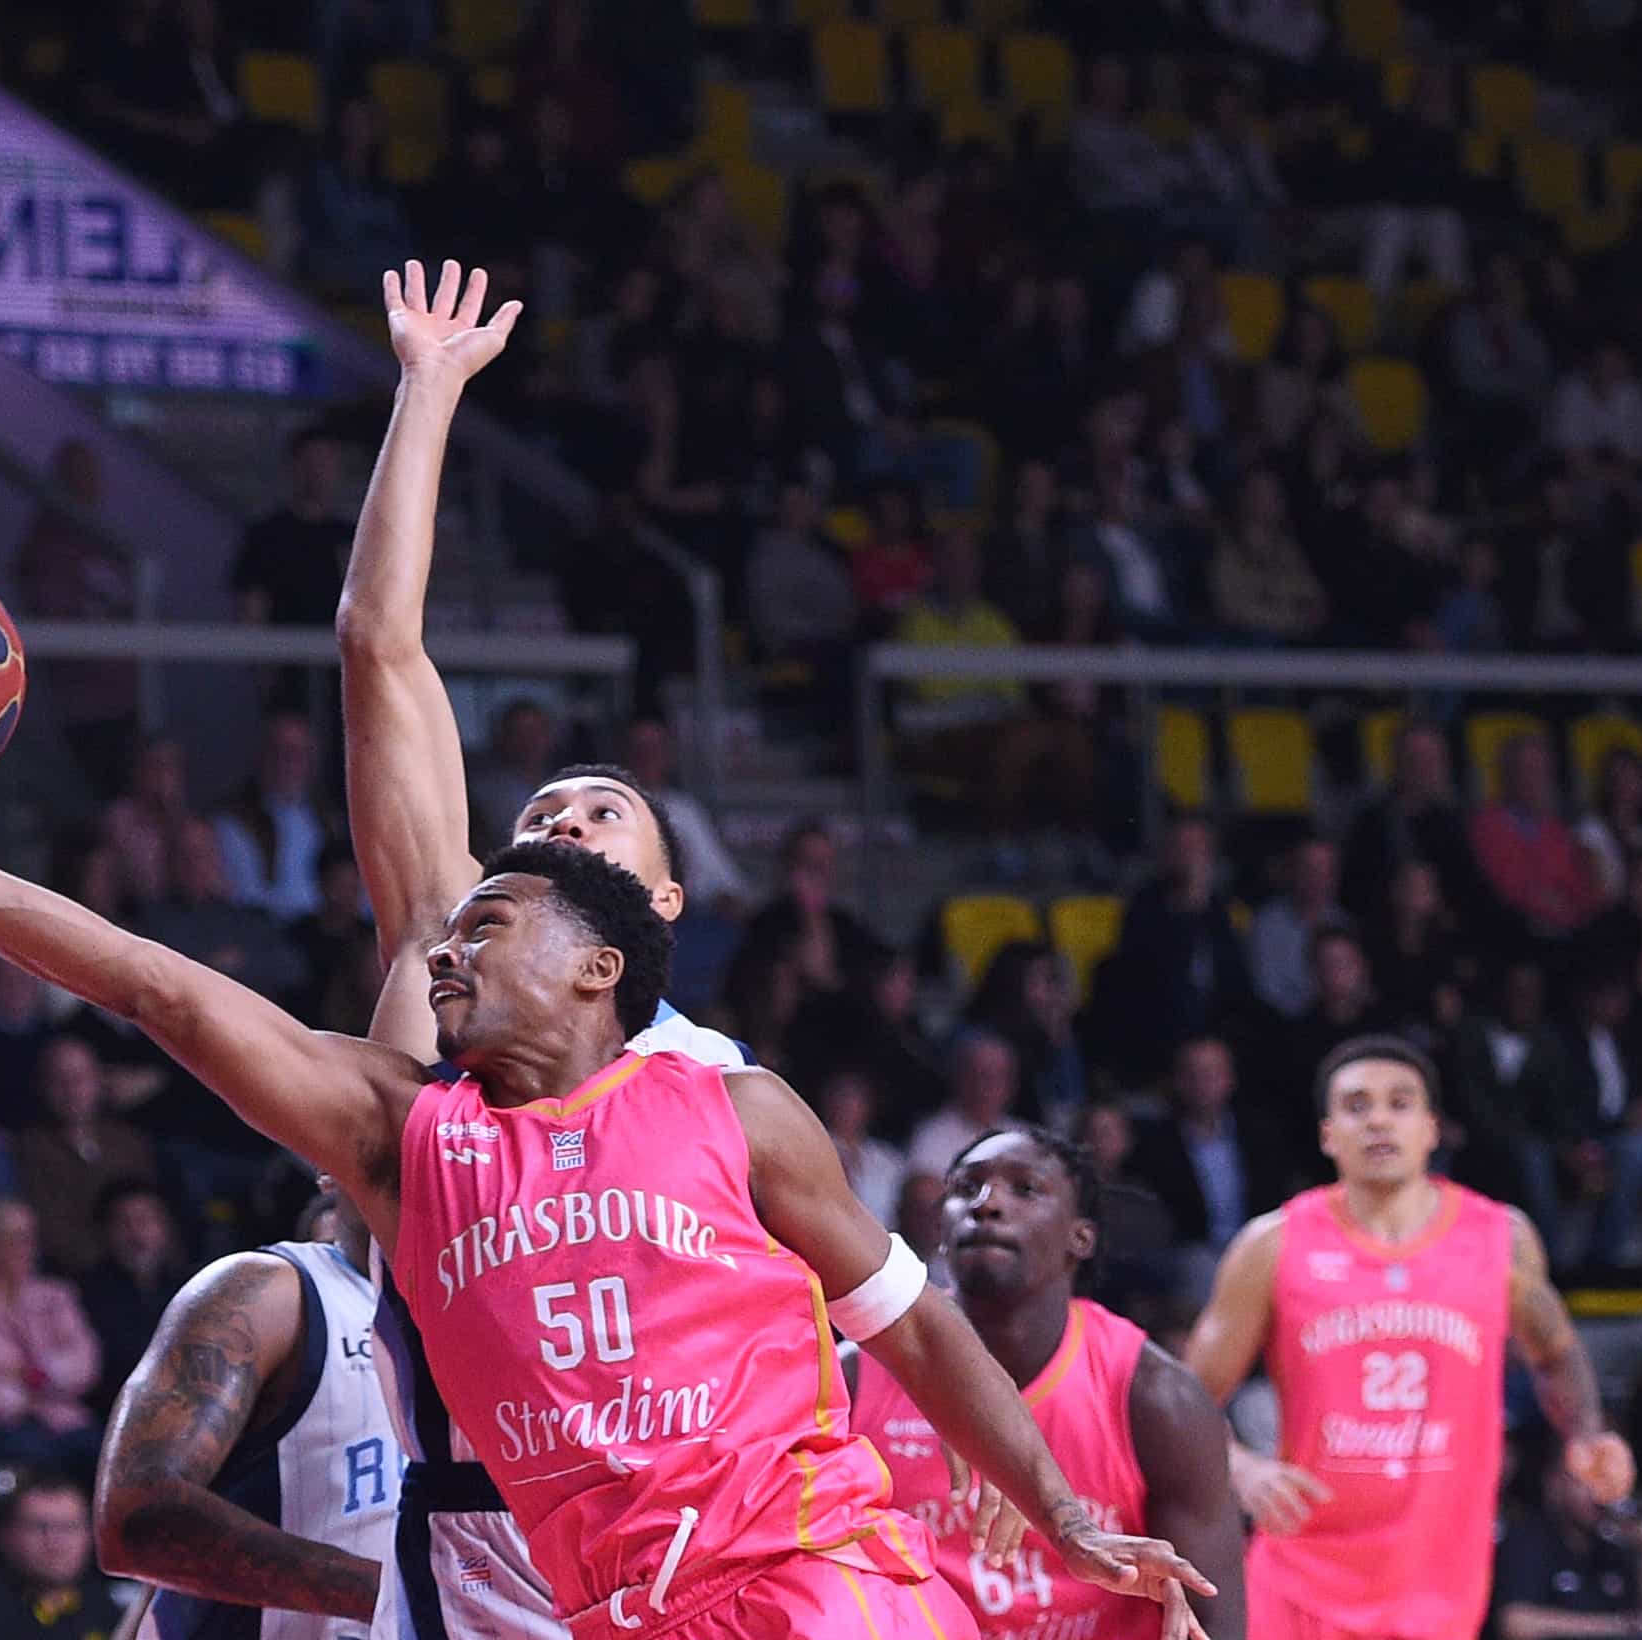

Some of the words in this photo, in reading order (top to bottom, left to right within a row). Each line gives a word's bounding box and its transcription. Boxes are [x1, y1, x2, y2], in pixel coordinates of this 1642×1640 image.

[437, 1188, 739, 1310] STRASBOURG
[533, 1276, 636, 1371] 50
[495, 1376, 720, 1464] Stradim
[1361, 1350, 1429, 1411] 22
[968, 1550, 1053, 1616] 64
